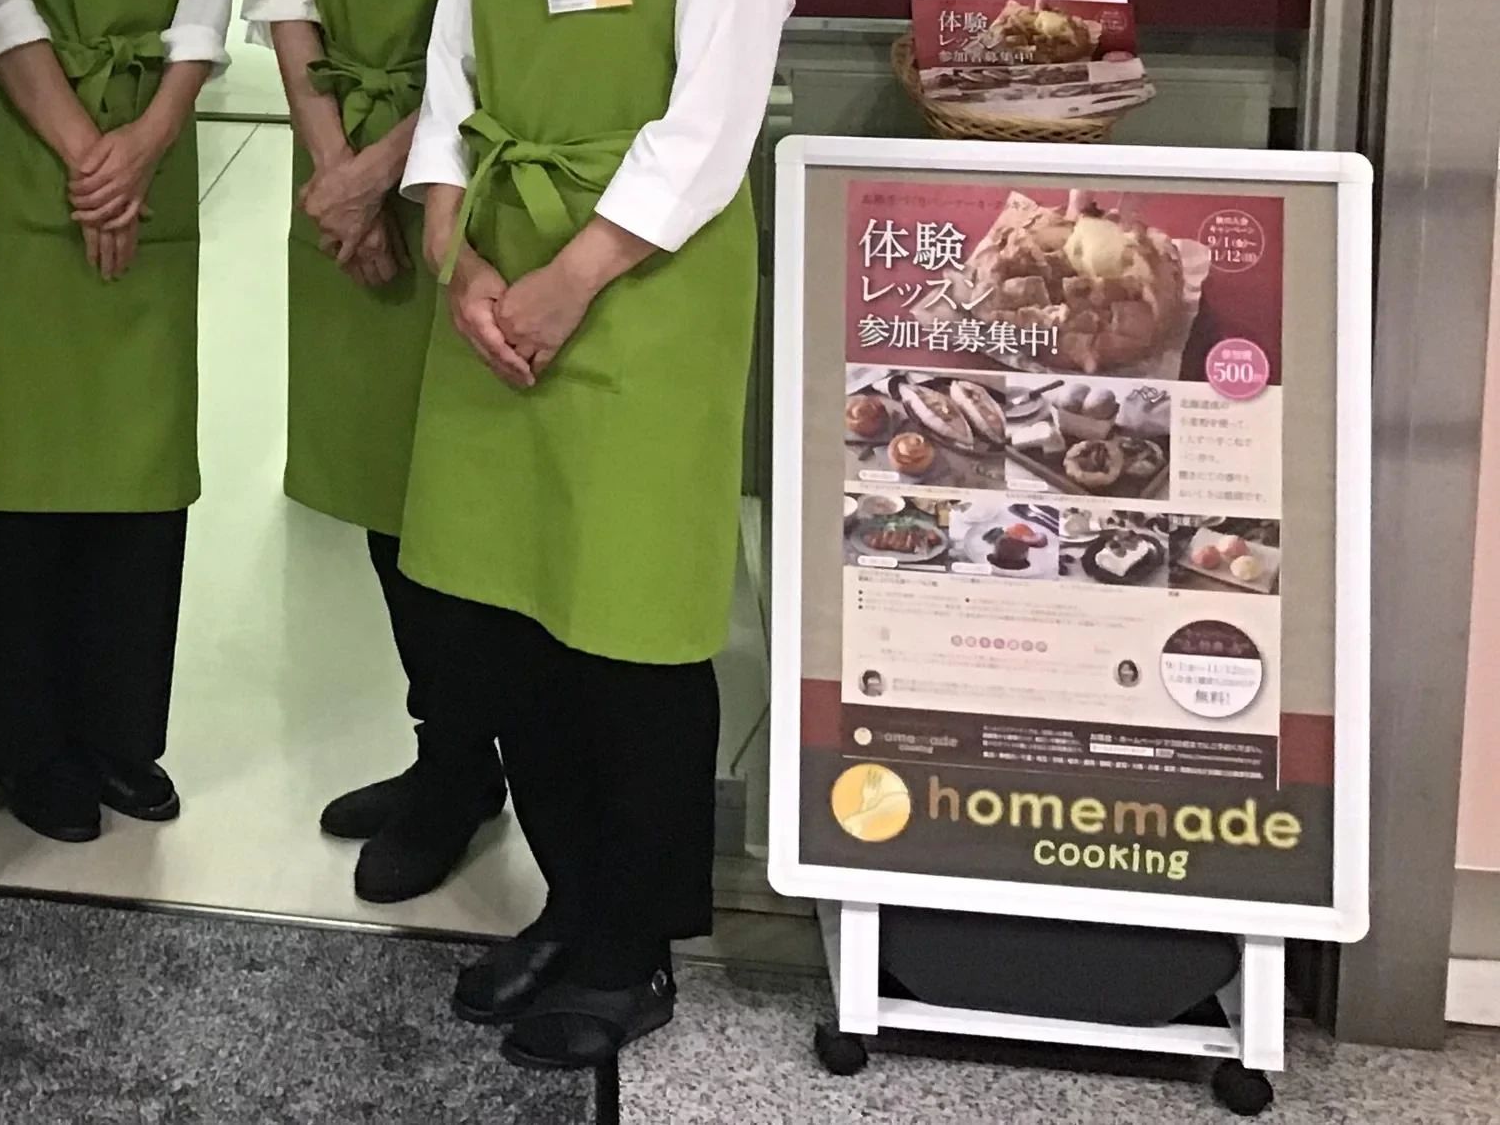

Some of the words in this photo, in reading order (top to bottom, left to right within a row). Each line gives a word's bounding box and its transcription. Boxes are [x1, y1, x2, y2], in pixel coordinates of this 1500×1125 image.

[938, 10, 989, 33] 体験
[858, 218, 967, 271] 体験
[861, 275, 995, 311] レッスン
[858, 313, 1059, 357] 参加者募集中!
[928, 775, 1303, 849] homemade
[1032, 838, 1190, 881] cooking
